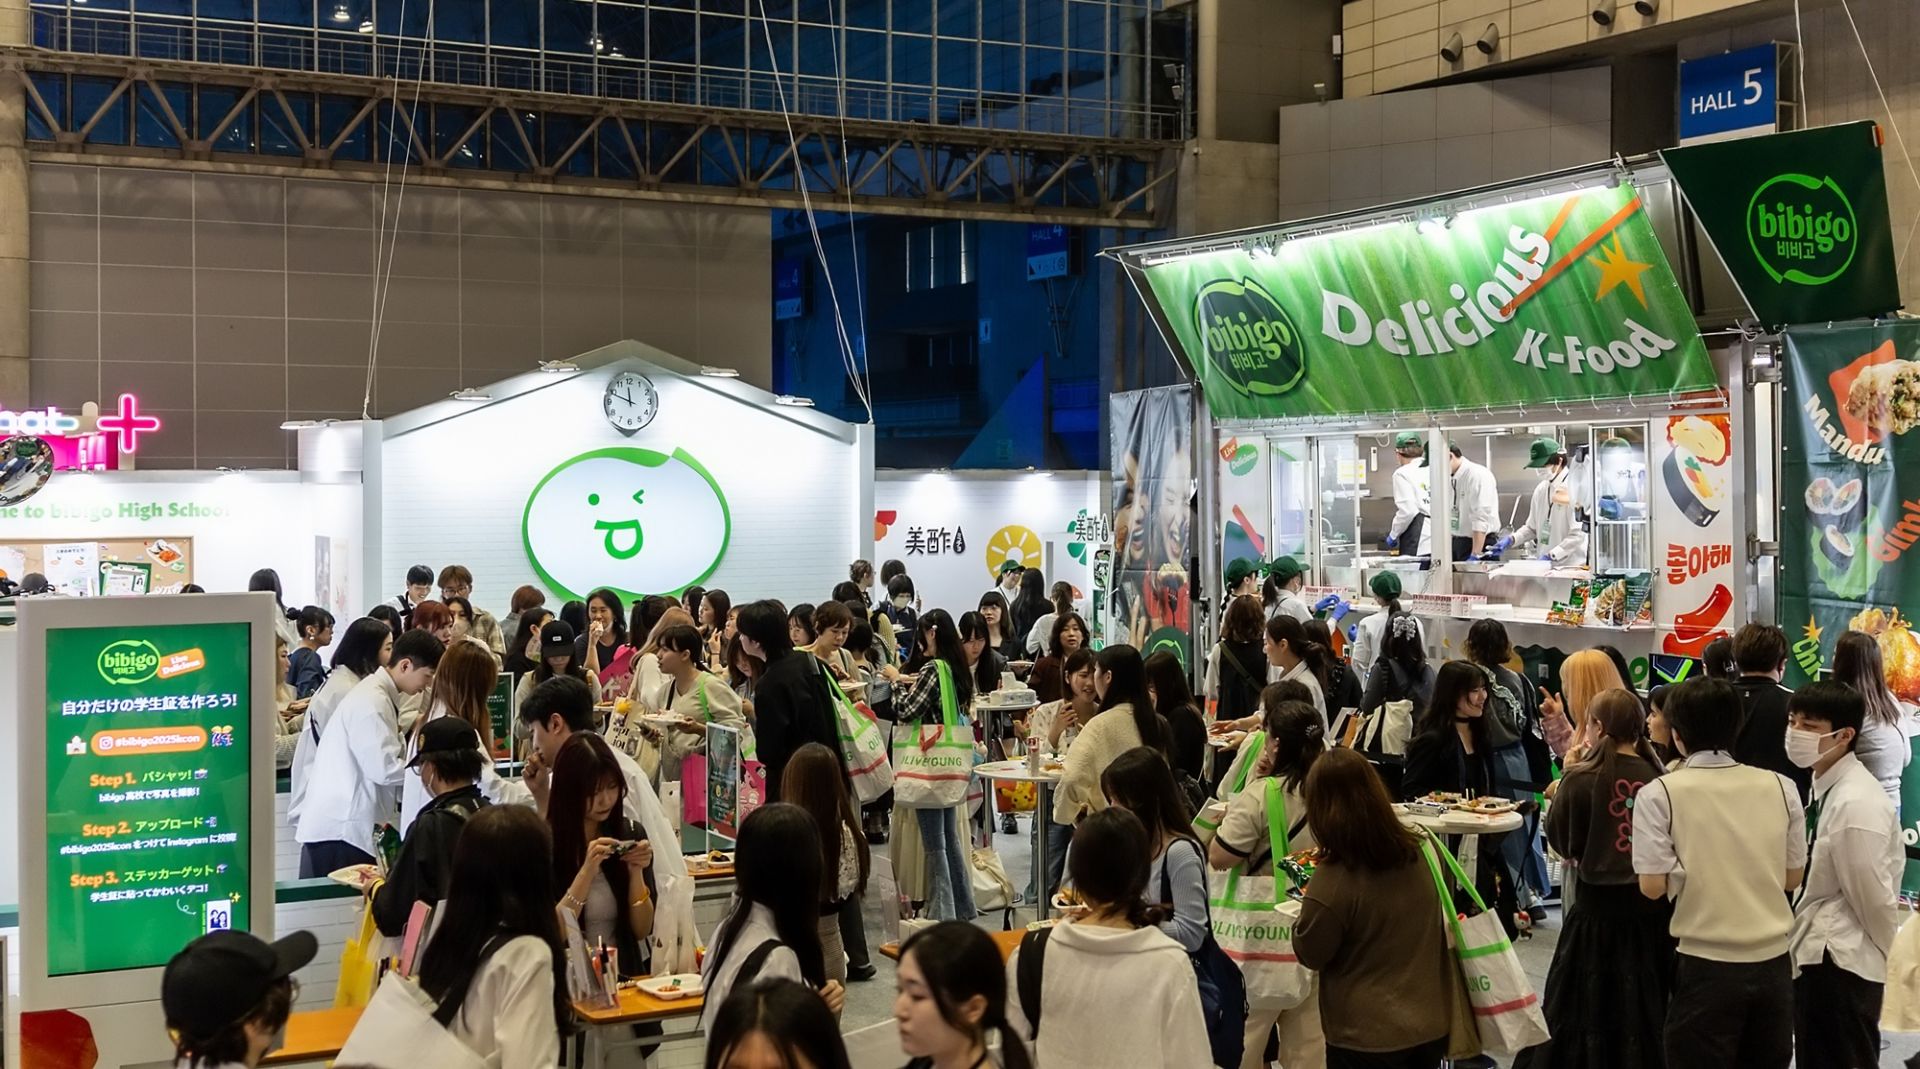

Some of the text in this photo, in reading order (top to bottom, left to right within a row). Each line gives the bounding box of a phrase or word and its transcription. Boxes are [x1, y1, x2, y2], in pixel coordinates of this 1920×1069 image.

[1691, 67, 1763, 115] HALL 5
[1031, 222, 1064, 241] HALL 4
[1757, 202, 1850, 253] bibigo
[1776, 240, 1816, 260] 비비고
[1321, 224, 1550, 356] Delicious
[1512, 317, 1678, 375] K-Food
[1229, 350, 1269, 371] 비비고
[1804, 393, 1886, 465] Mandu
[24, 504, 45, 518] to
[51, 503, 113, 522] bibigo
[118, 503, 163, 521] High
[905, 526, 952, 556] 美酢
[1667, 543, 1732, 585] 좋아해
[104, 651, 157, 670] bibigo
[162, 659, 201, 675] Delicious
[170, 654, 189, 665] Live
[113, 667, 136, 675] 비비고
[62, 693, 238, 716] 自分だけの学生証を作ろう!
[115, 733, 201, 748] #bibigo2025kcon
[89, 773, 124, 788] Step
[124, 772, 137, 784] 1.
[98, 793, 125, 803] bibigo
[82, 817, 204, 838] Step 2. アップロード
[70, 864, 214, 888] Step 3. ステッカーゲット
